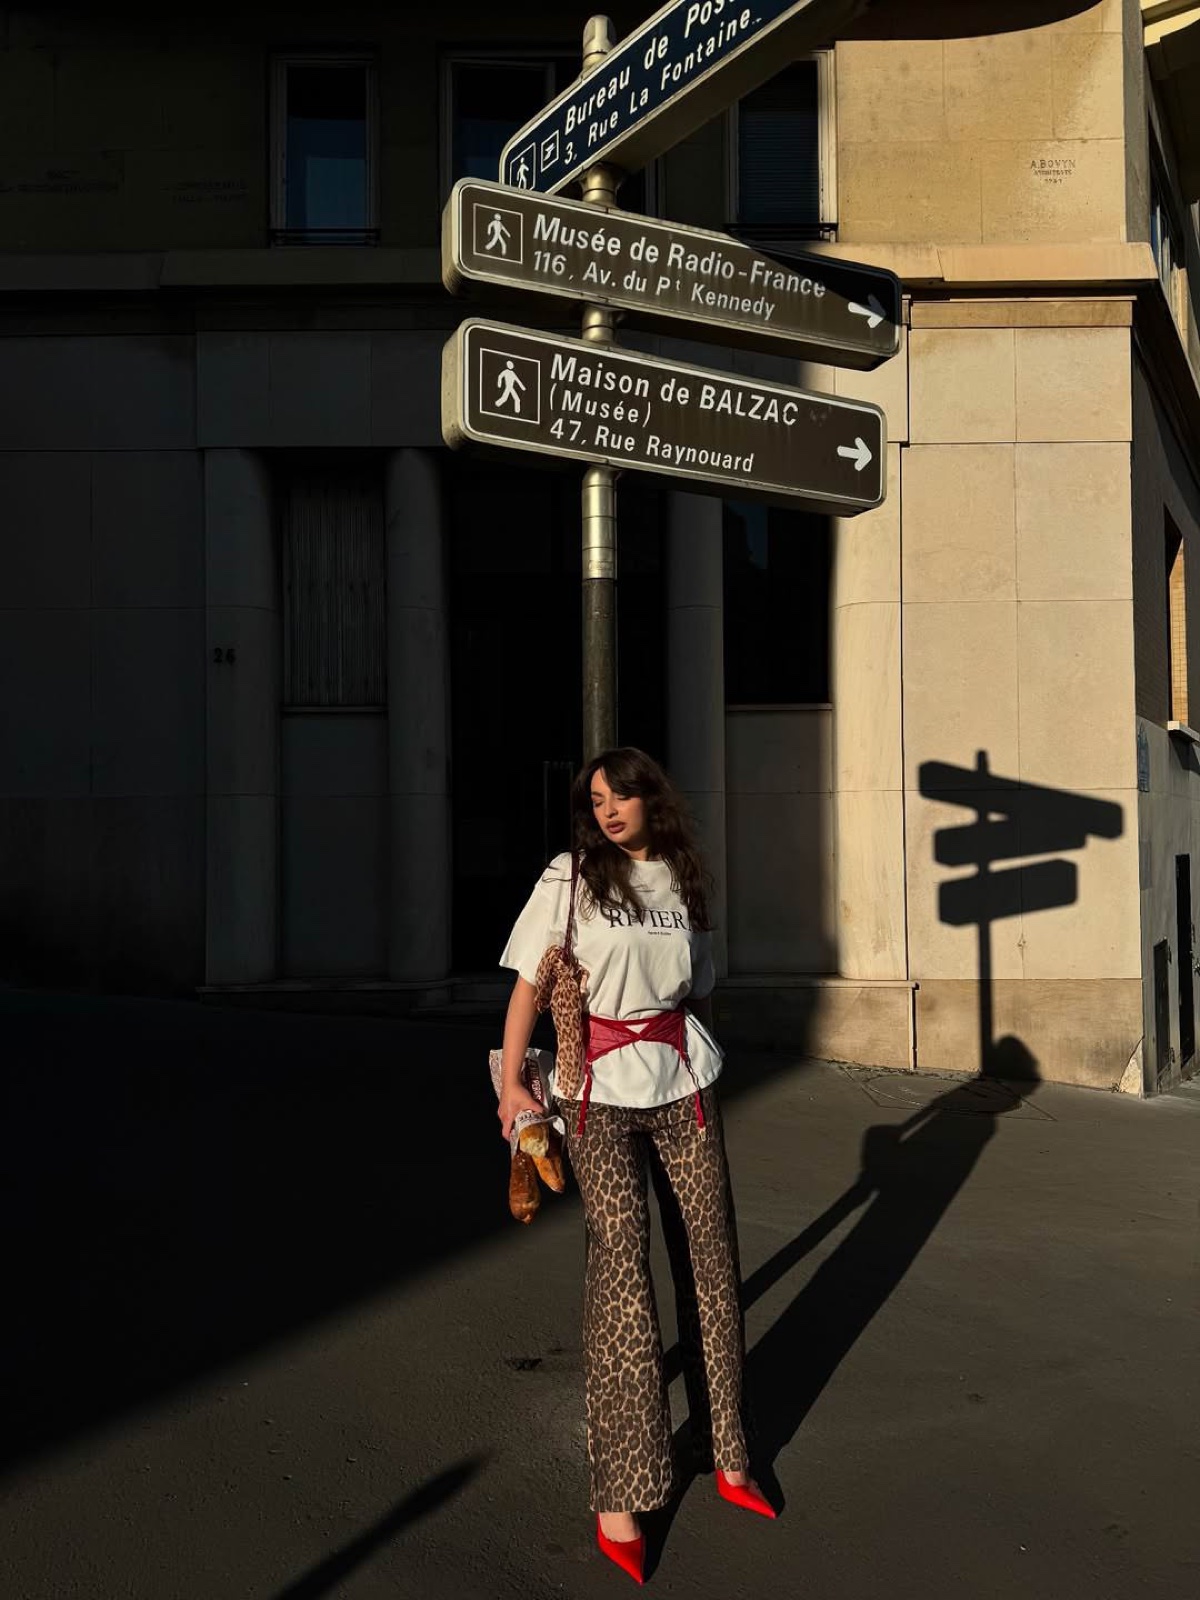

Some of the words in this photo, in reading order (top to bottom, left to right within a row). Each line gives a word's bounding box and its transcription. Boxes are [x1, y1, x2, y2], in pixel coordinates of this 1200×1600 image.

[564, 65, 630, 136] Bureau
[643, 35, 669, 71] de
[684, 0, 745, 39] Pos
[587, 110, 619, 148] Rue
[629, 87, 649, 115] La
[533, 213, 622, 256] Musée
[629, 236, 660, 265] de
[667, 242, 827, 299] Radio-France
[582, 262, 617, 288] Av.
[622, 270, 648, 294] du
[690, 283, 776, 321] Kennedy
[549, 382, 652, 428] (Musée)
[550, 353, 650, 398] Maison
[660, 377, 690, 405] de
[700, 383, 799, 426] BALZAC
[550, 419, 588, 446] 47,
[595, 424, 636, 453] Rue
[646, 434, 754, 473] Raynouard
[609, 908, 693, 931] RIVIER
